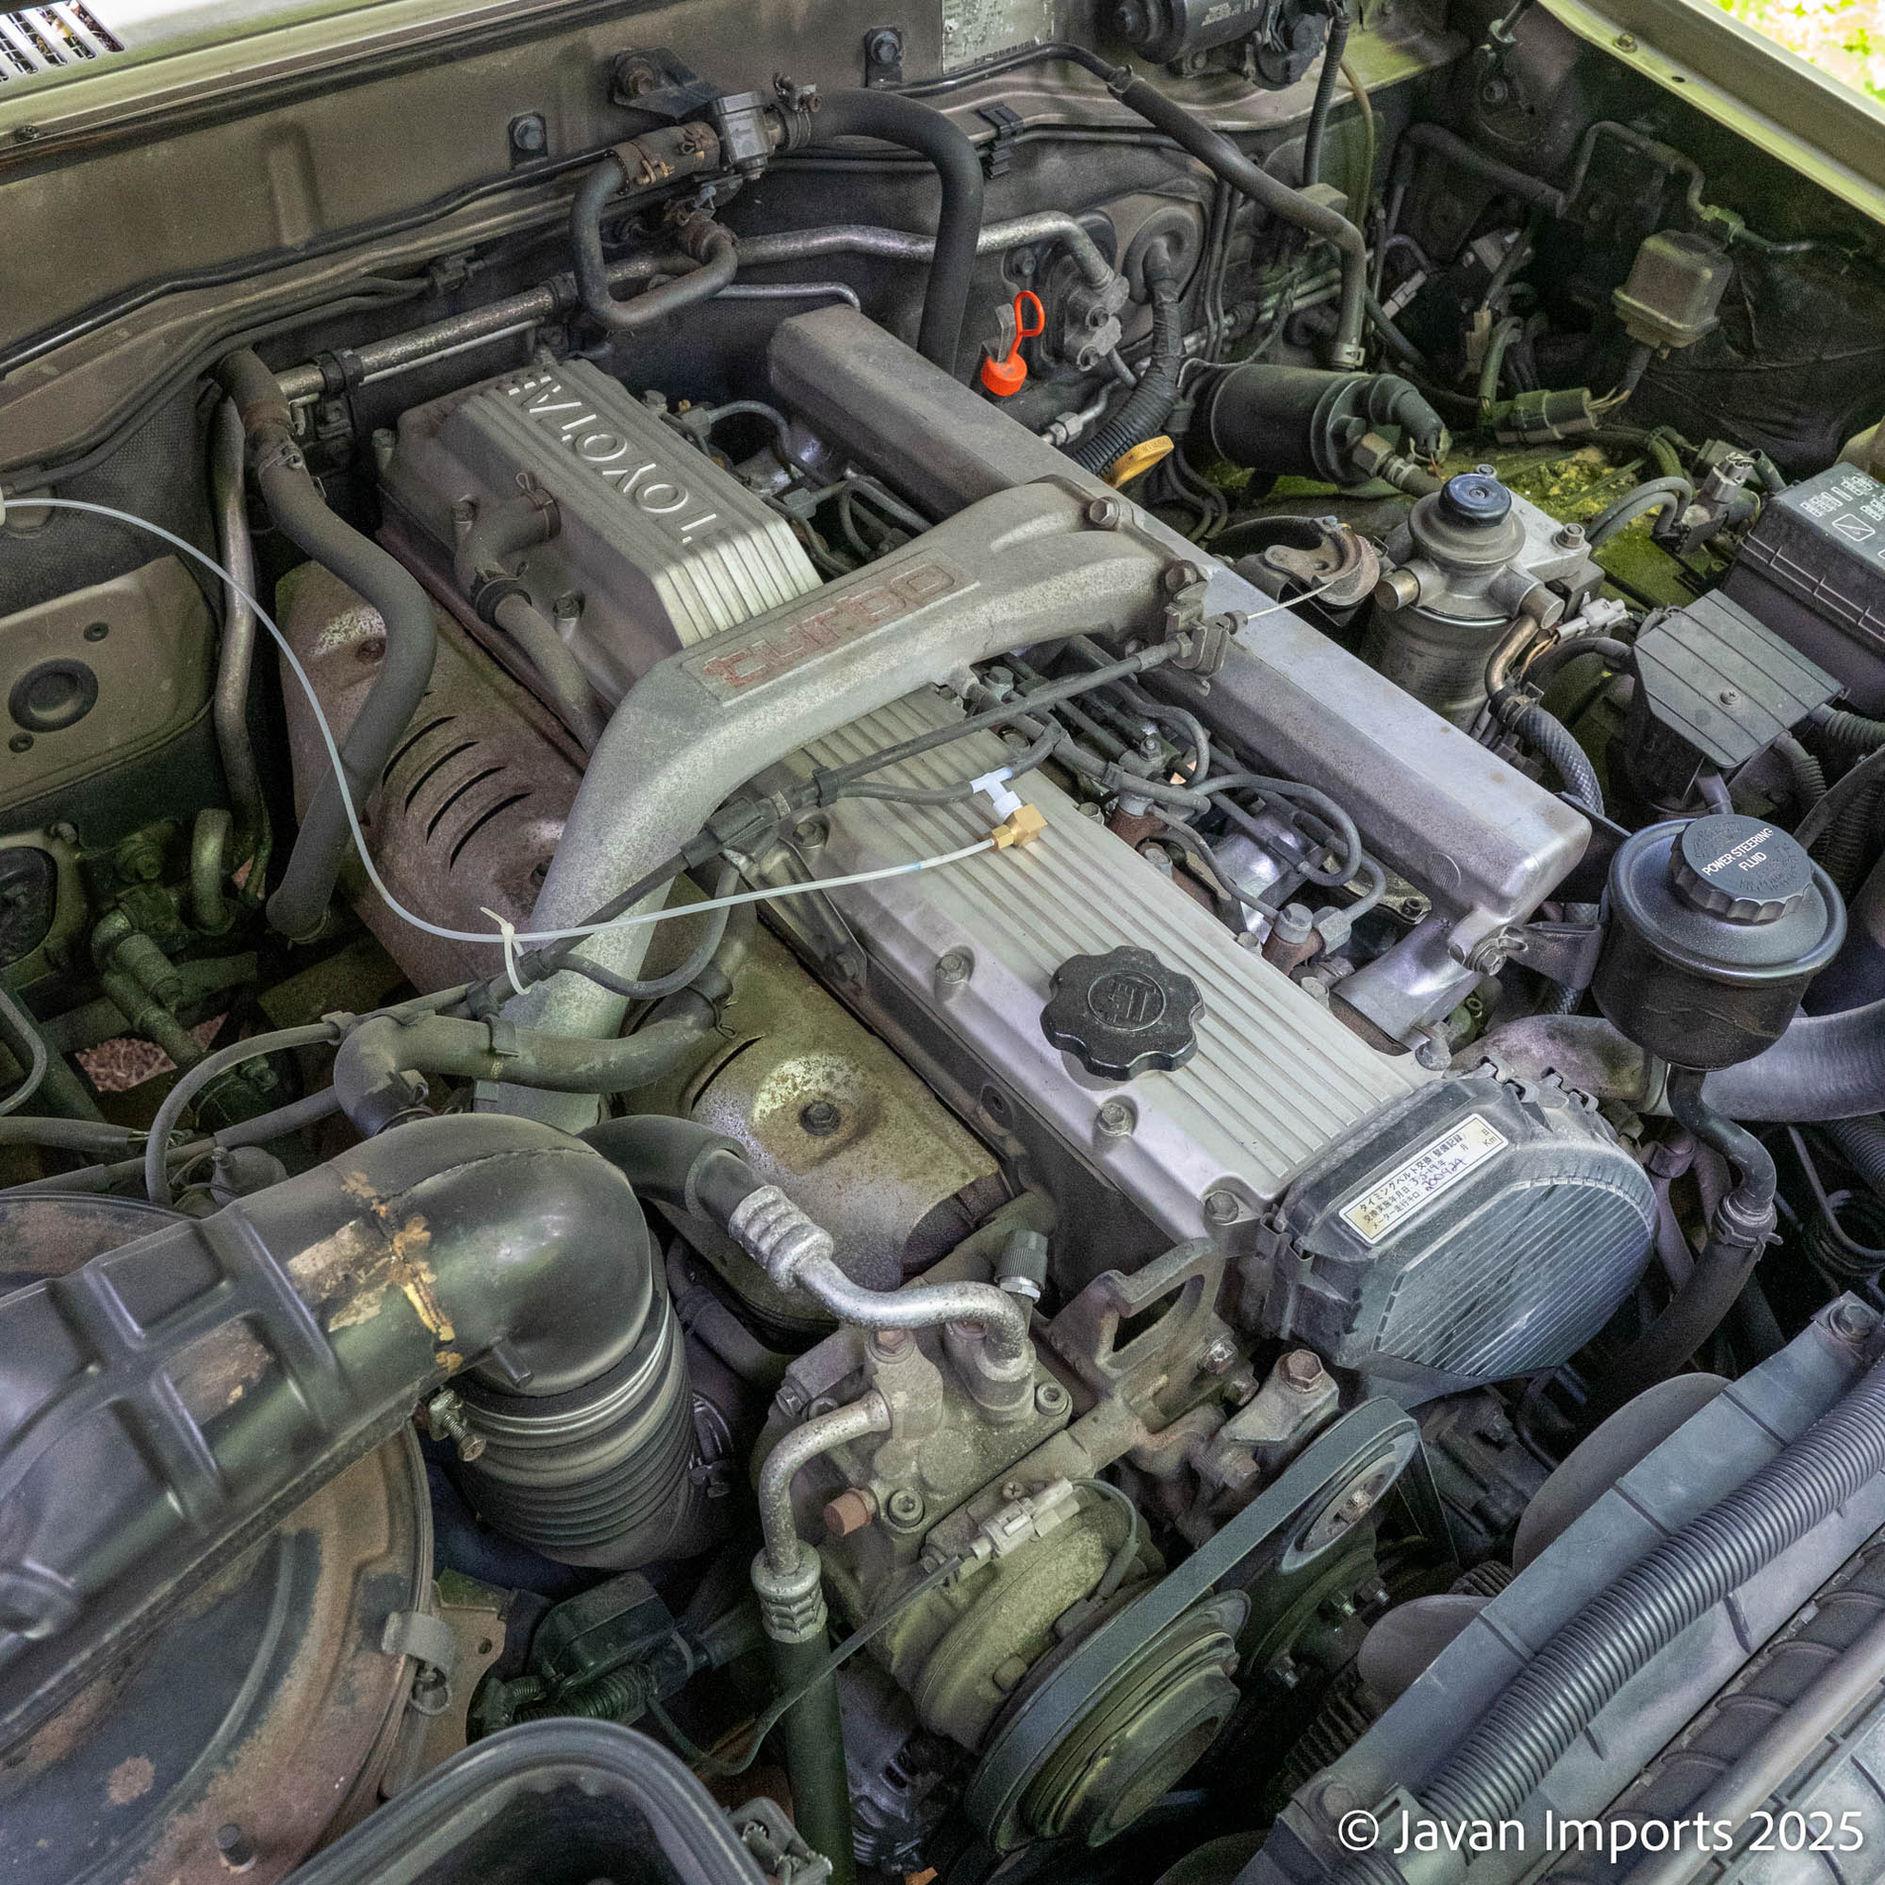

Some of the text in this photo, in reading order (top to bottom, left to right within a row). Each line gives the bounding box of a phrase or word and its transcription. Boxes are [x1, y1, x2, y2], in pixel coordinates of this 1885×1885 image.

[508, 375, 718, 544] TOYOTA
[1702, 853, 1735, 876] POWER
[1731, 828, 1774, 857] STEERING
[1739, 852, 1767, 871] FLUID
